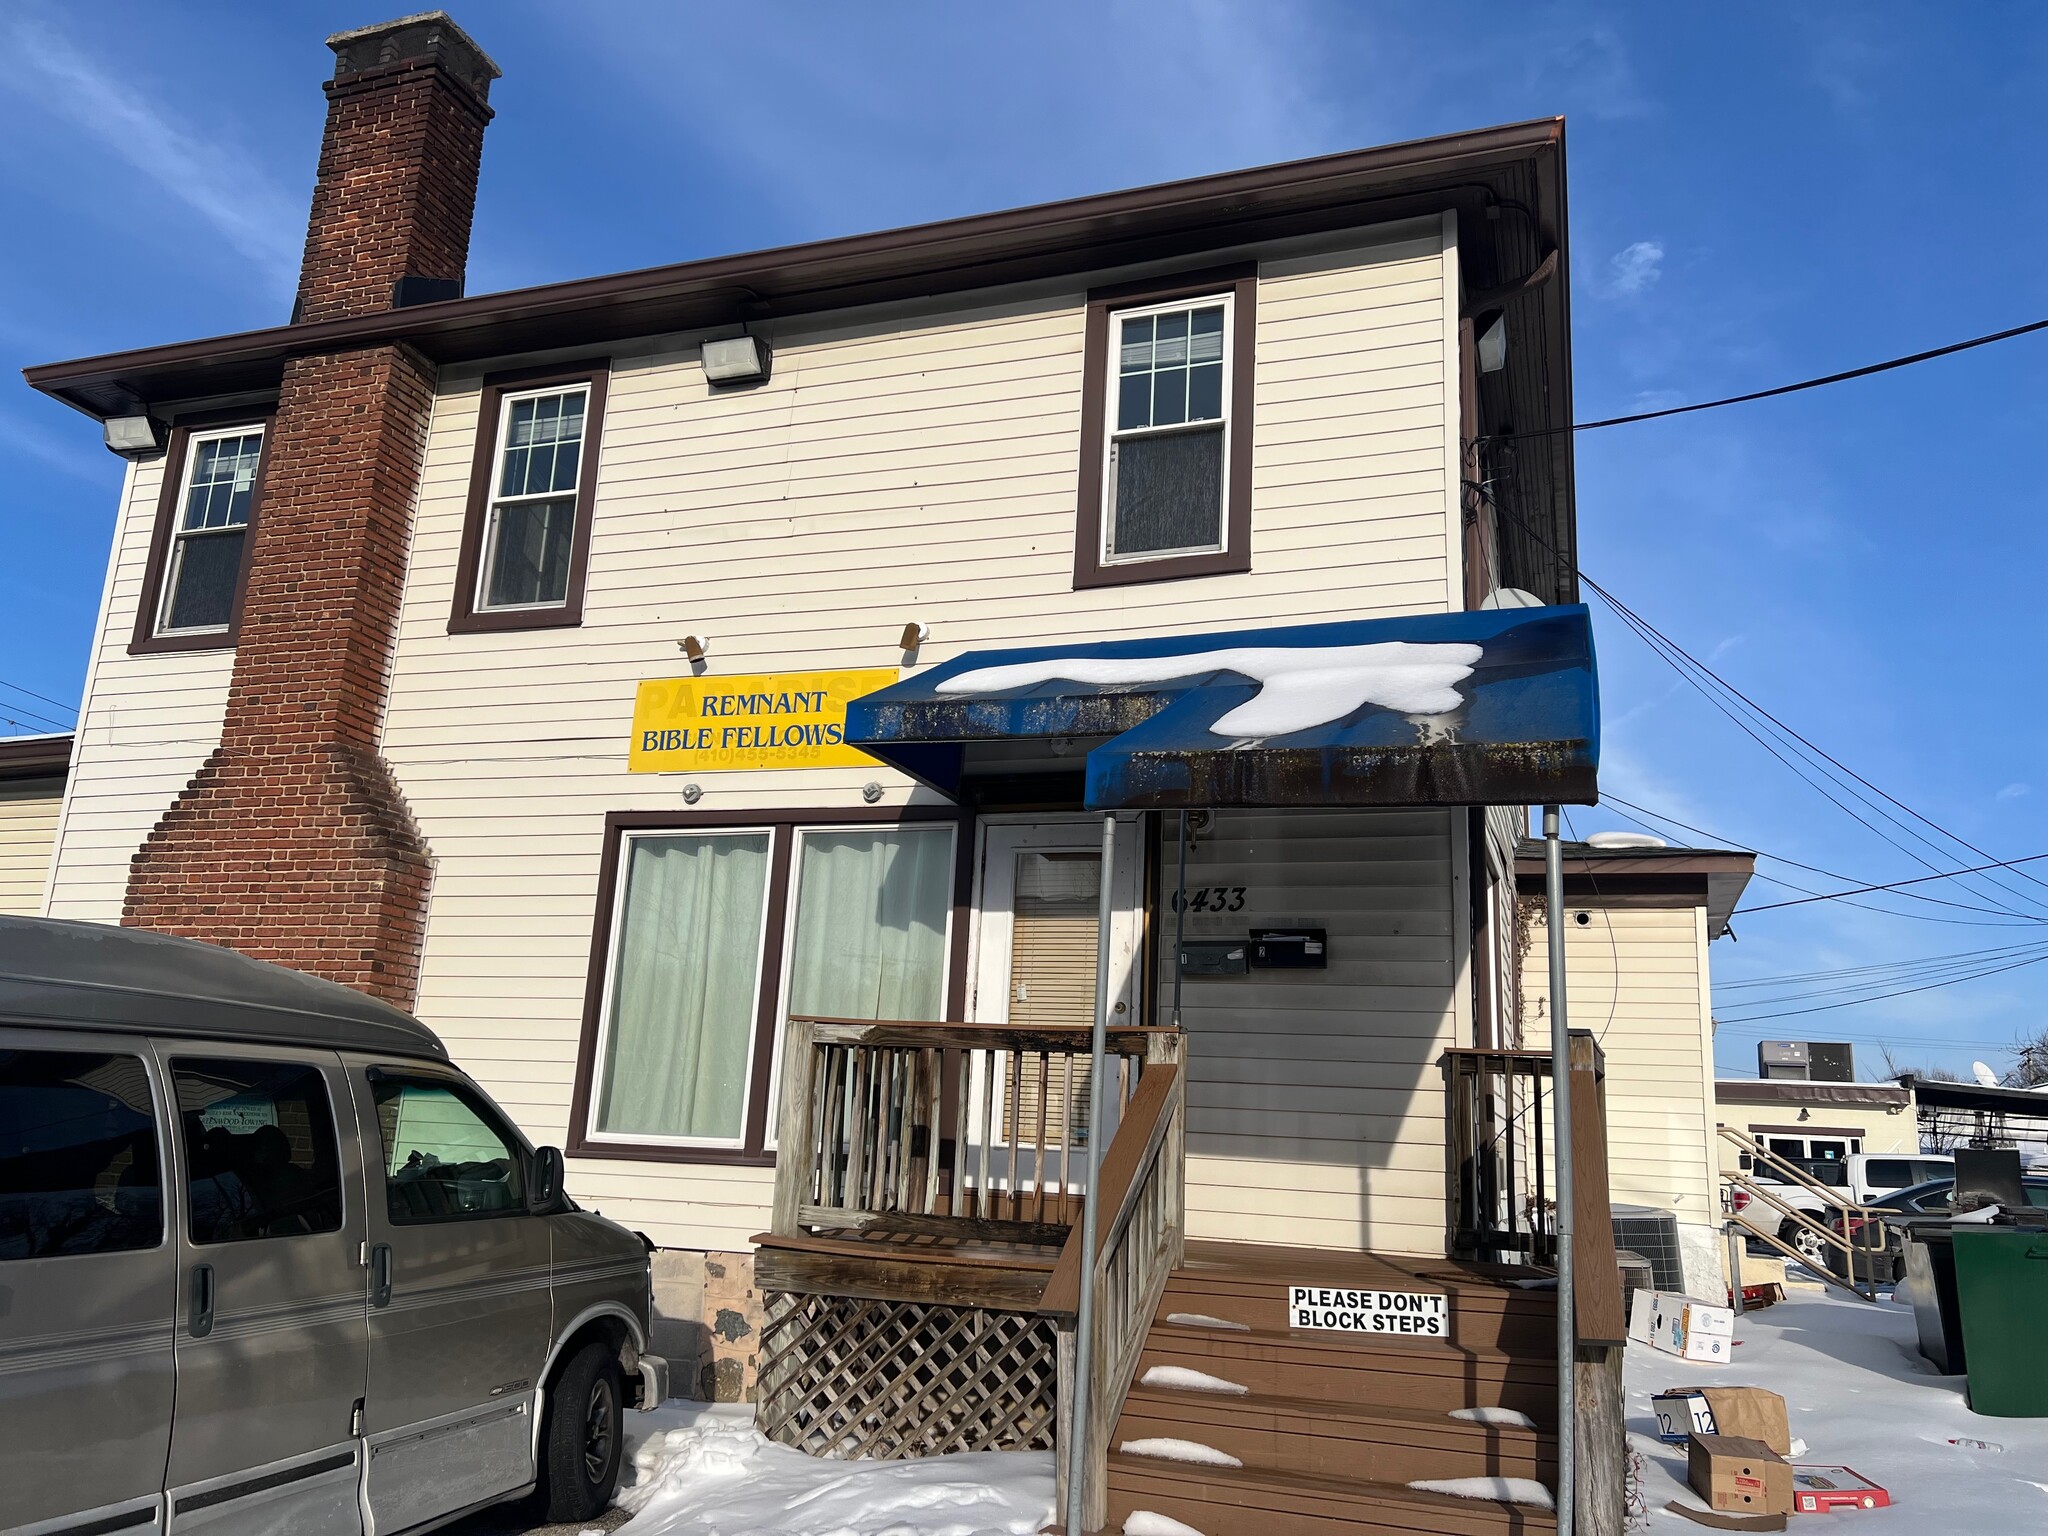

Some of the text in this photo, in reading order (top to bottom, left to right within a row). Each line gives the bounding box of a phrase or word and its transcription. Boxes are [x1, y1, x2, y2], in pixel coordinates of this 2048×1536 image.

[700, 690, 828, 717] REMNANT
[641, 727, 713, 752] BIBLE
[720, 722, 846, 749] FELLOWS
[694, 746, 821, 765] (410)455-5345
[1172, 886, 1247, 914] 6433
[1294, 1288, 1442, 1313] PLEASE DON'T
[1298, 1309, 1440, 1335] BLOCK STEPS
[1657, 1413, 1675, 1434] 12
[1694, 1411, 1717, 1434] 12
